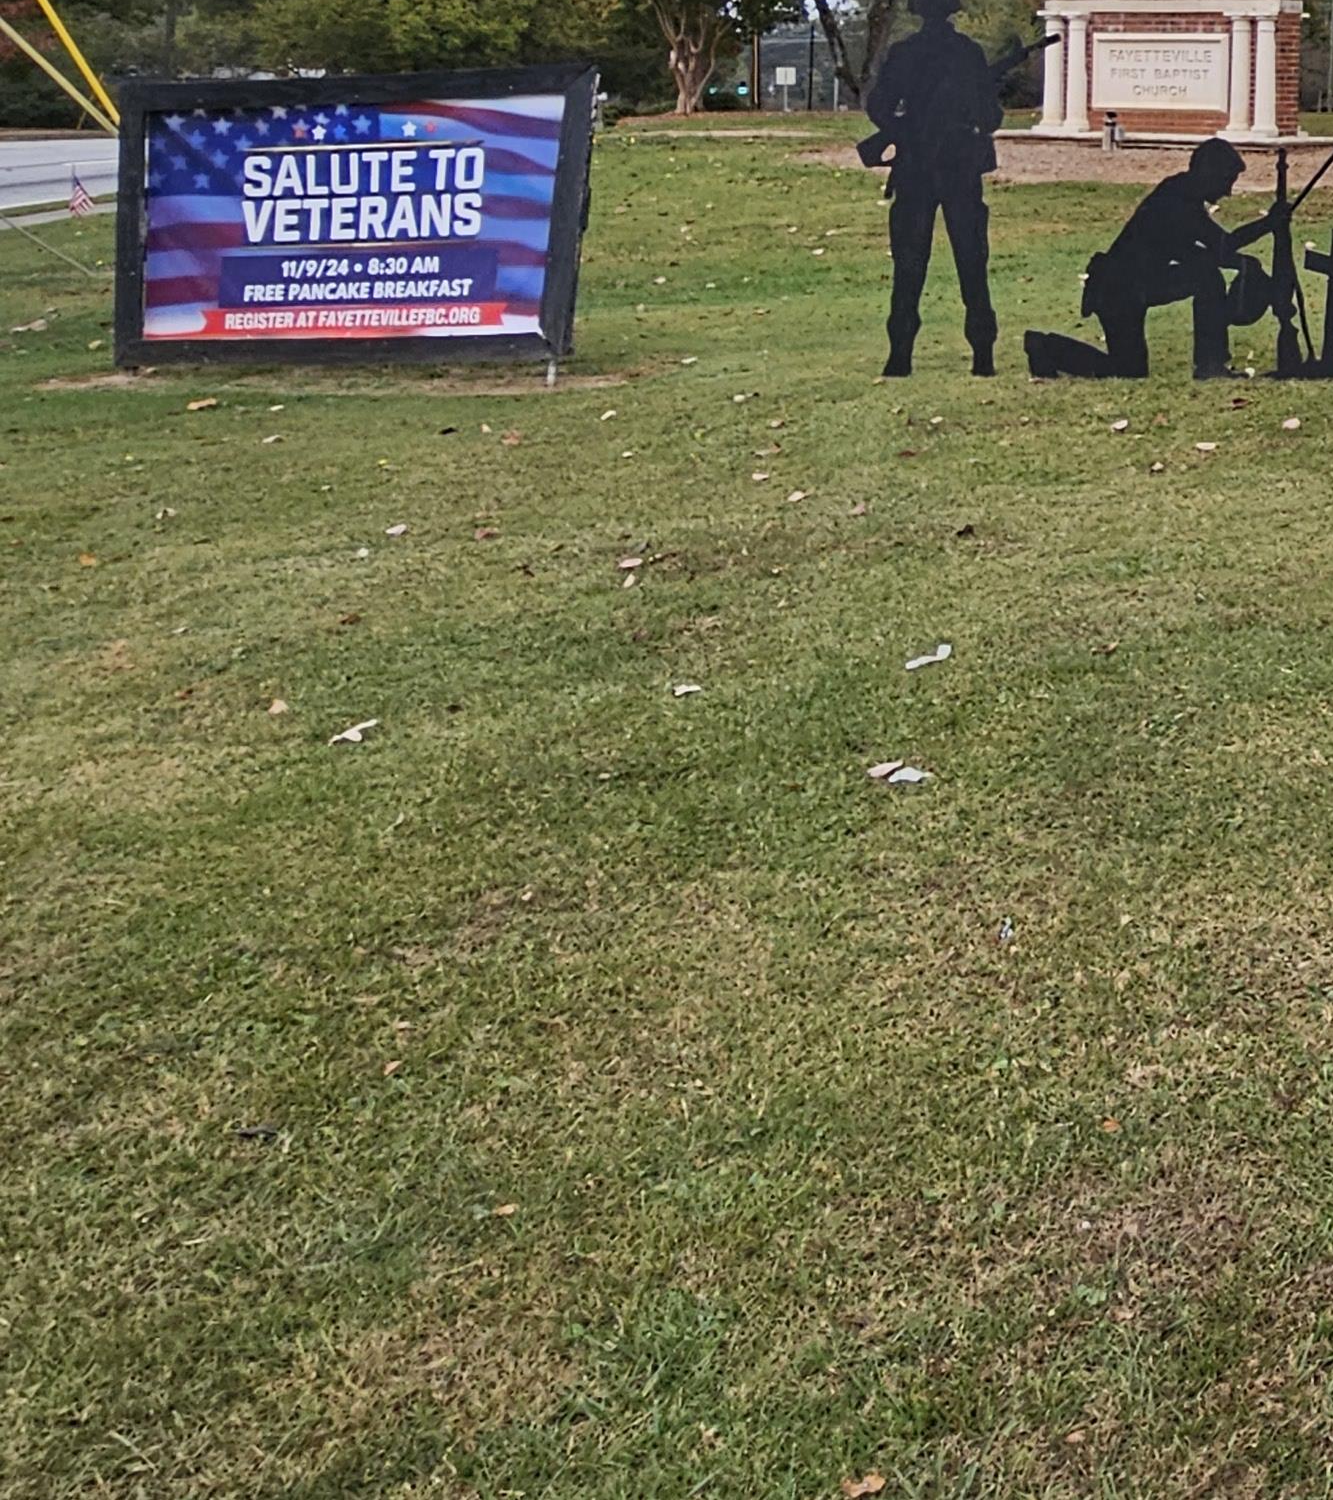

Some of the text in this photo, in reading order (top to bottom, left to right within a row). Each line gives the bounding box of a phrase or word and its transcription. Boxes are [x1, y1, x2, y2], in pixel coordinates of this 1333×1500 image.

[1109, 49, 1212, 63] FAYETTEVILLE
[1110, 68, 1209, 80] FIRST BAPTIST
[1132, 85, 1187, 96] CHURCH
[243, 148, 485, 197] SALUTE TO
[242, 193, 483, 243] VETERANS
[281, 256, 440, 279] 11/9/24 8:30 AM
[243, 279, 473, 302] FREE PANCAKE BREAKFAST
[224, 307, 481, 330] REGISTER AT FAYETTEVILLEFBC.ORG
